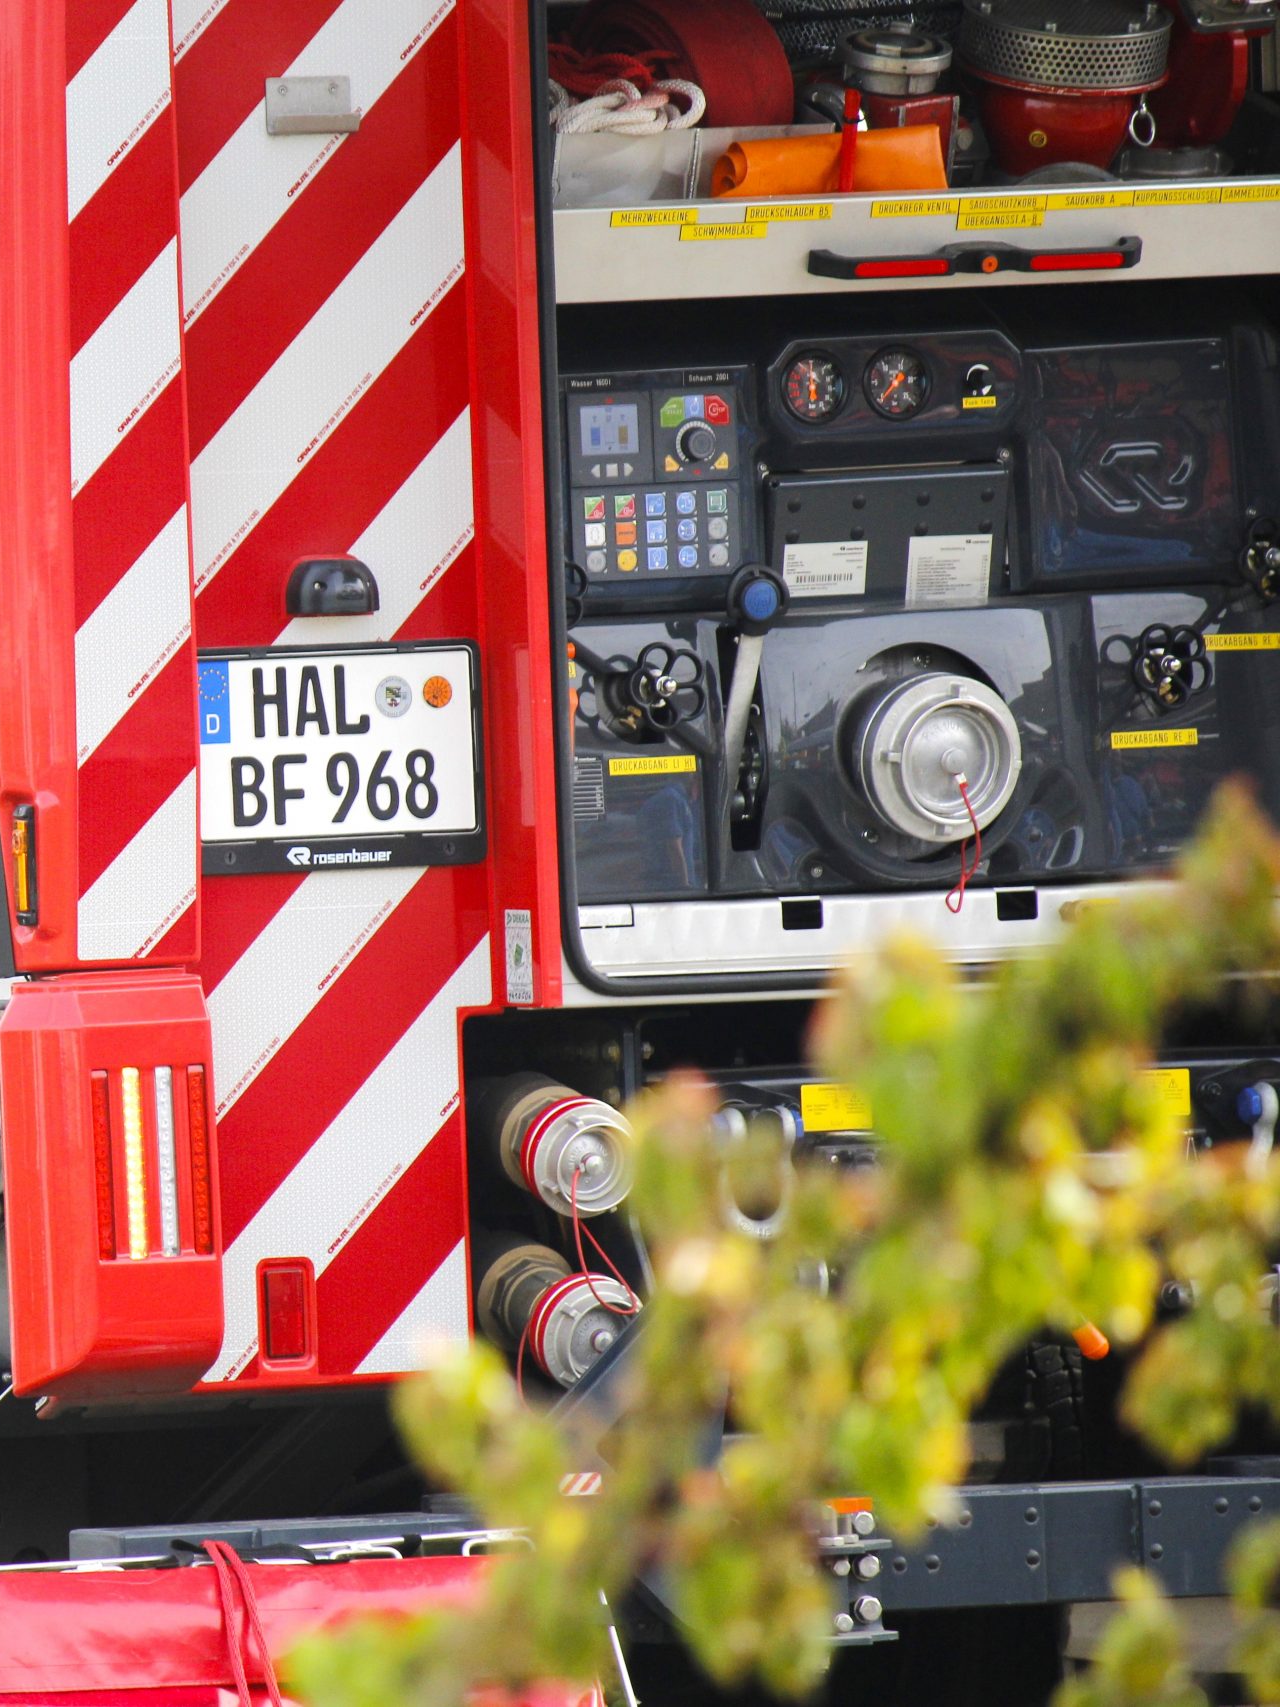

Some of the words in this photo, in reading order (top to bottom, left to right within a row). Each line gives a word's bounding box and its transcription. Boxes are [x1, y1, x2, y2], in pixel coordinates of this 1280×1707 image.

[399, 33, 422, 61] ORALITE
[105, 140, 129, 166] ORALITE
[285, 171, 309, 198] ORALITE
[879, 202, 924, 214] DRUCKBEGR
[969, 198, 1037, 210] SAUGSCHUTZKORB
[1065, 195, 1105, 206] SAUGKORB
[1109, 195, 1116, 204] A
[620, 211, 689, 223] MEHRZWECKLEINE
[750, 206, 815, 219] DRUCKSCHLAUCH
[693, 225, 755, 237] SCHWIMMBLASE
[408, 299, 432, 326] ORALITE
[571, 380, 593, 388] Wasser
[688, 374, 713, 382] Schaum
[116, 406, 139, 433] ORALITE
[295, 436, 319, 463] ORALITE
[418, 564, 441, 591] ORALITE
[126, 672, 149, 699] ORALITE
[252, 664, 370, 738] HAL
[206, 714, 220, 734] D
[1113, 732, 1169, 745] DRUCKABGANG
[613, 760, 668, 772] DRUCKABGANG
[231, 753, 307, 827] BF
[325, 748, 439, 824] 968
[313, 848, 392, 865] rosenbauer
[315, 964, 339, 991] ORALITE
[325, 1228, 349, 1255] ORALITE
